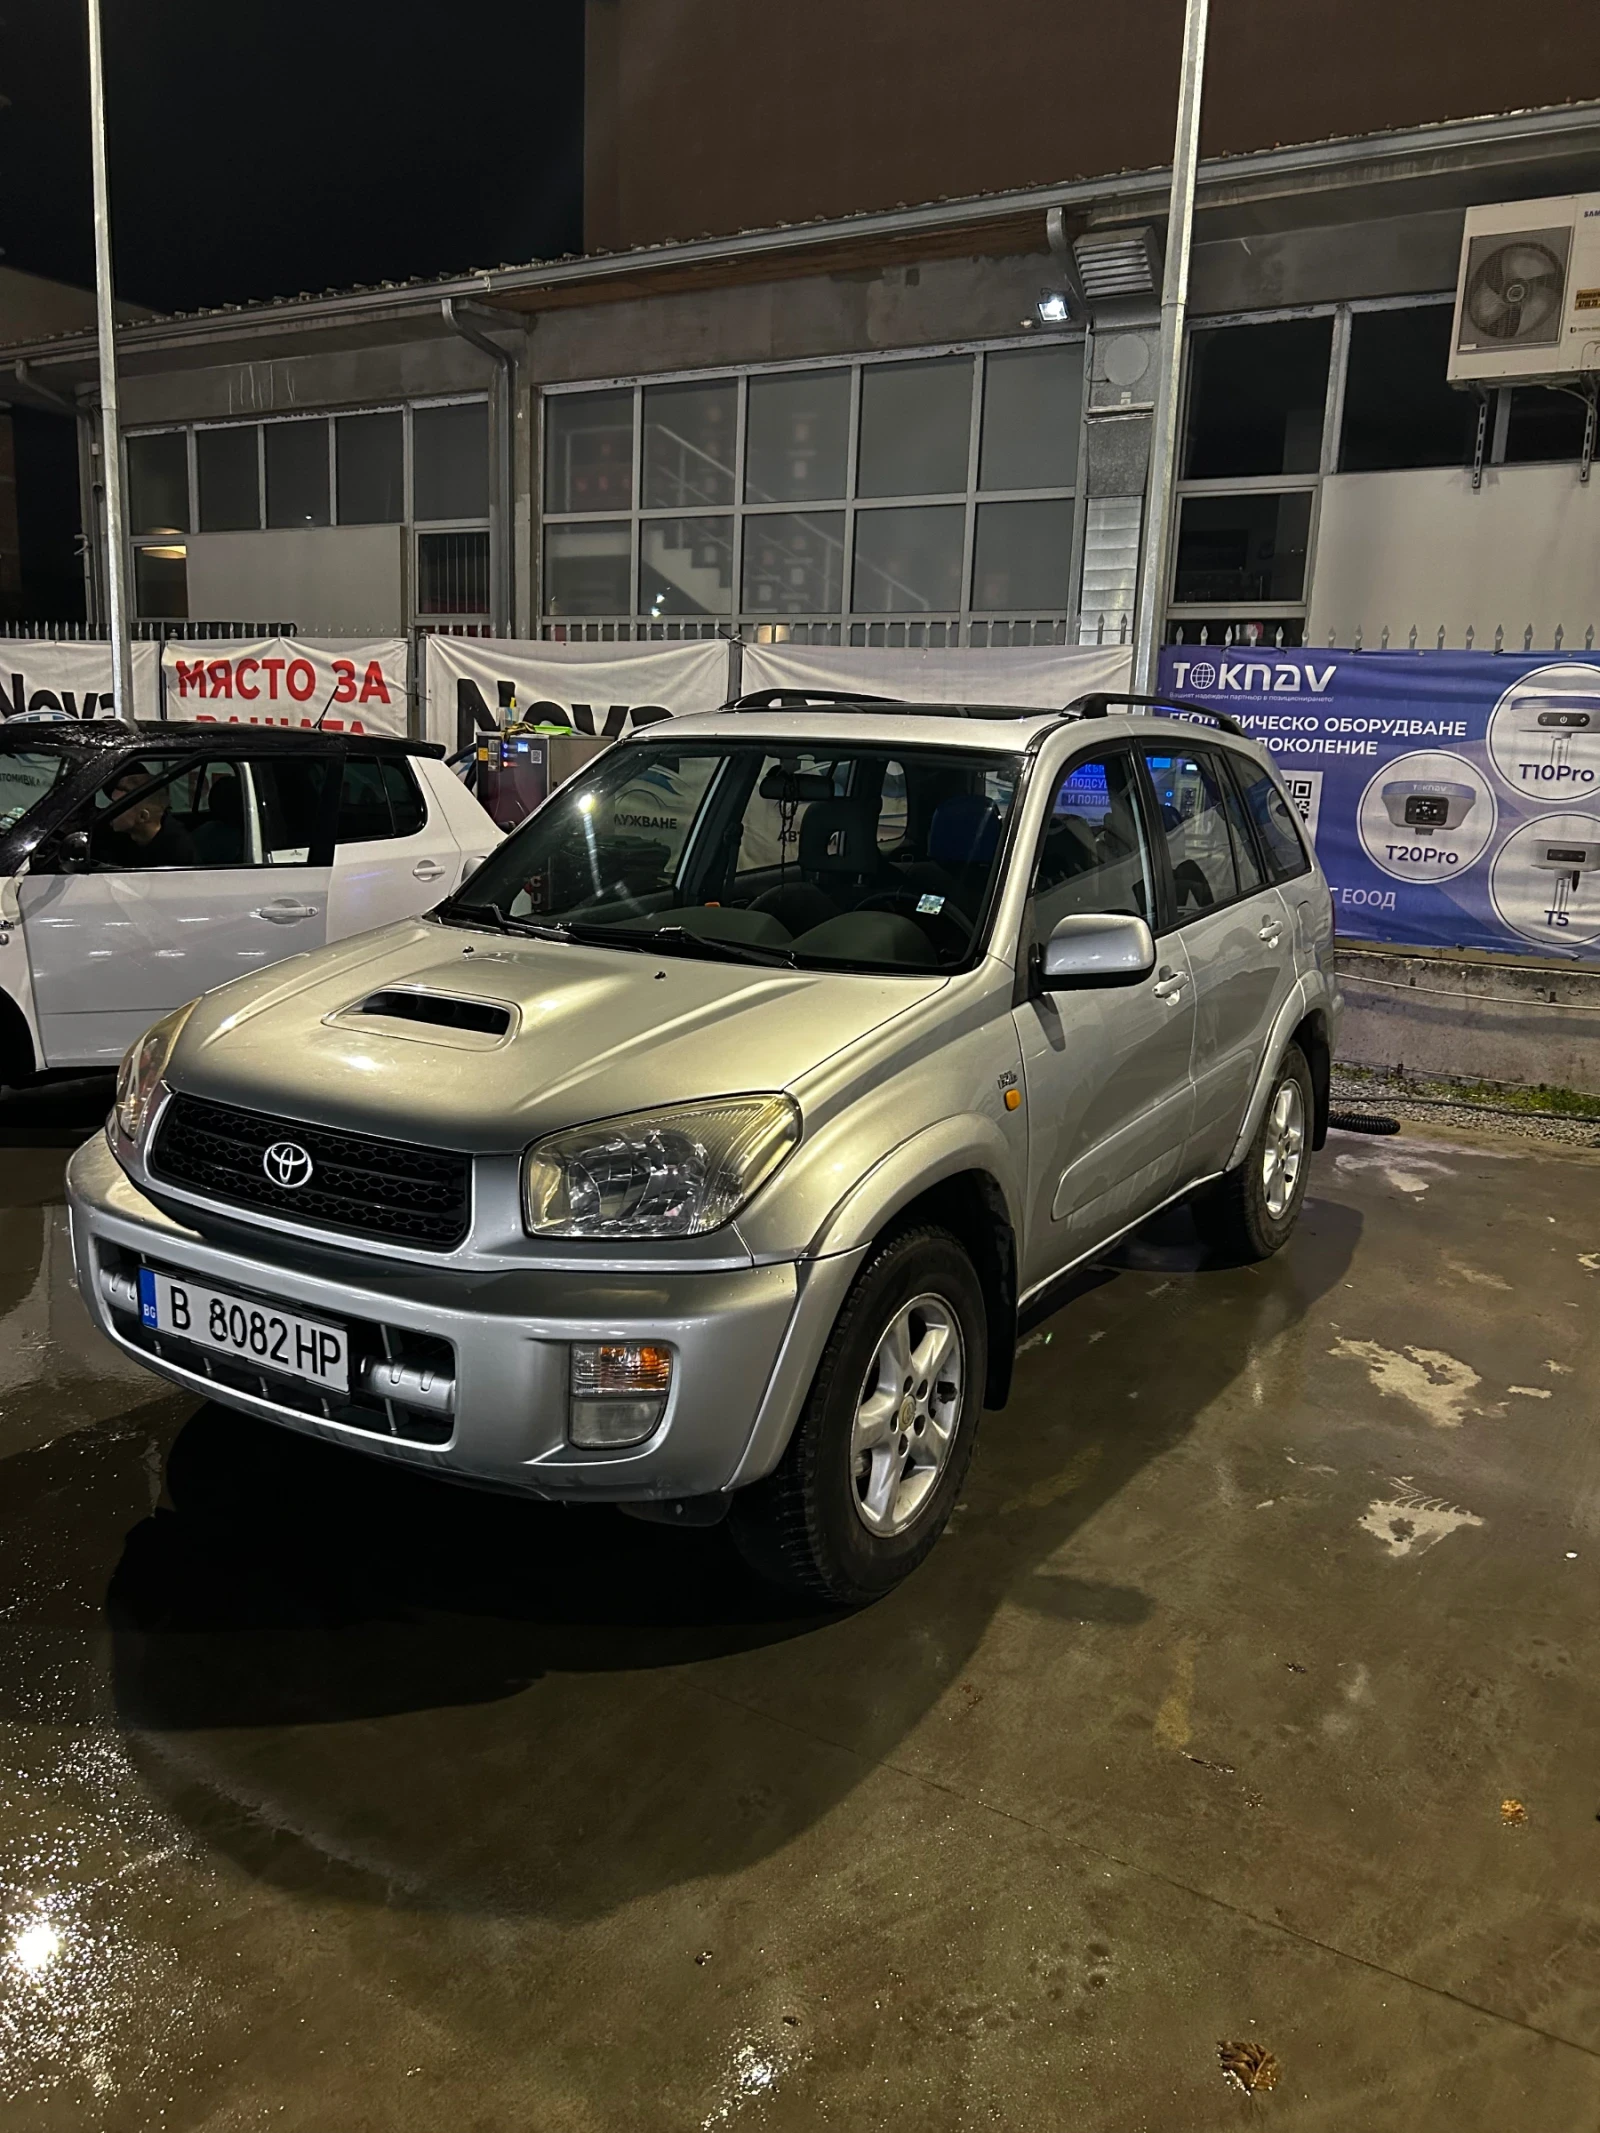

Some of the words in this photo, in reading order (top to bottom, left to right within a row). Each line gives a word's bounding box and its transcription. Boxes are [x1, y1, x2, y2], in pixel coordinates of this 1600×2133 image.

[175, 658, 316, 702] МЯСТО
[331, 660, 391, 704] ЗА
[1324, 717, 1468, 737] ОБОРУДВАНЕ
[1518, 763, 1595, 782] T10Pro
[1385, 845, 1459, 865] T20Pro
[1341, 888, 1397, 911] ЕООД
[1544, 909, 1570, 927] T5
[143, 1303, 156, 1319] BG
[170, 1285, 192, 1331] B
